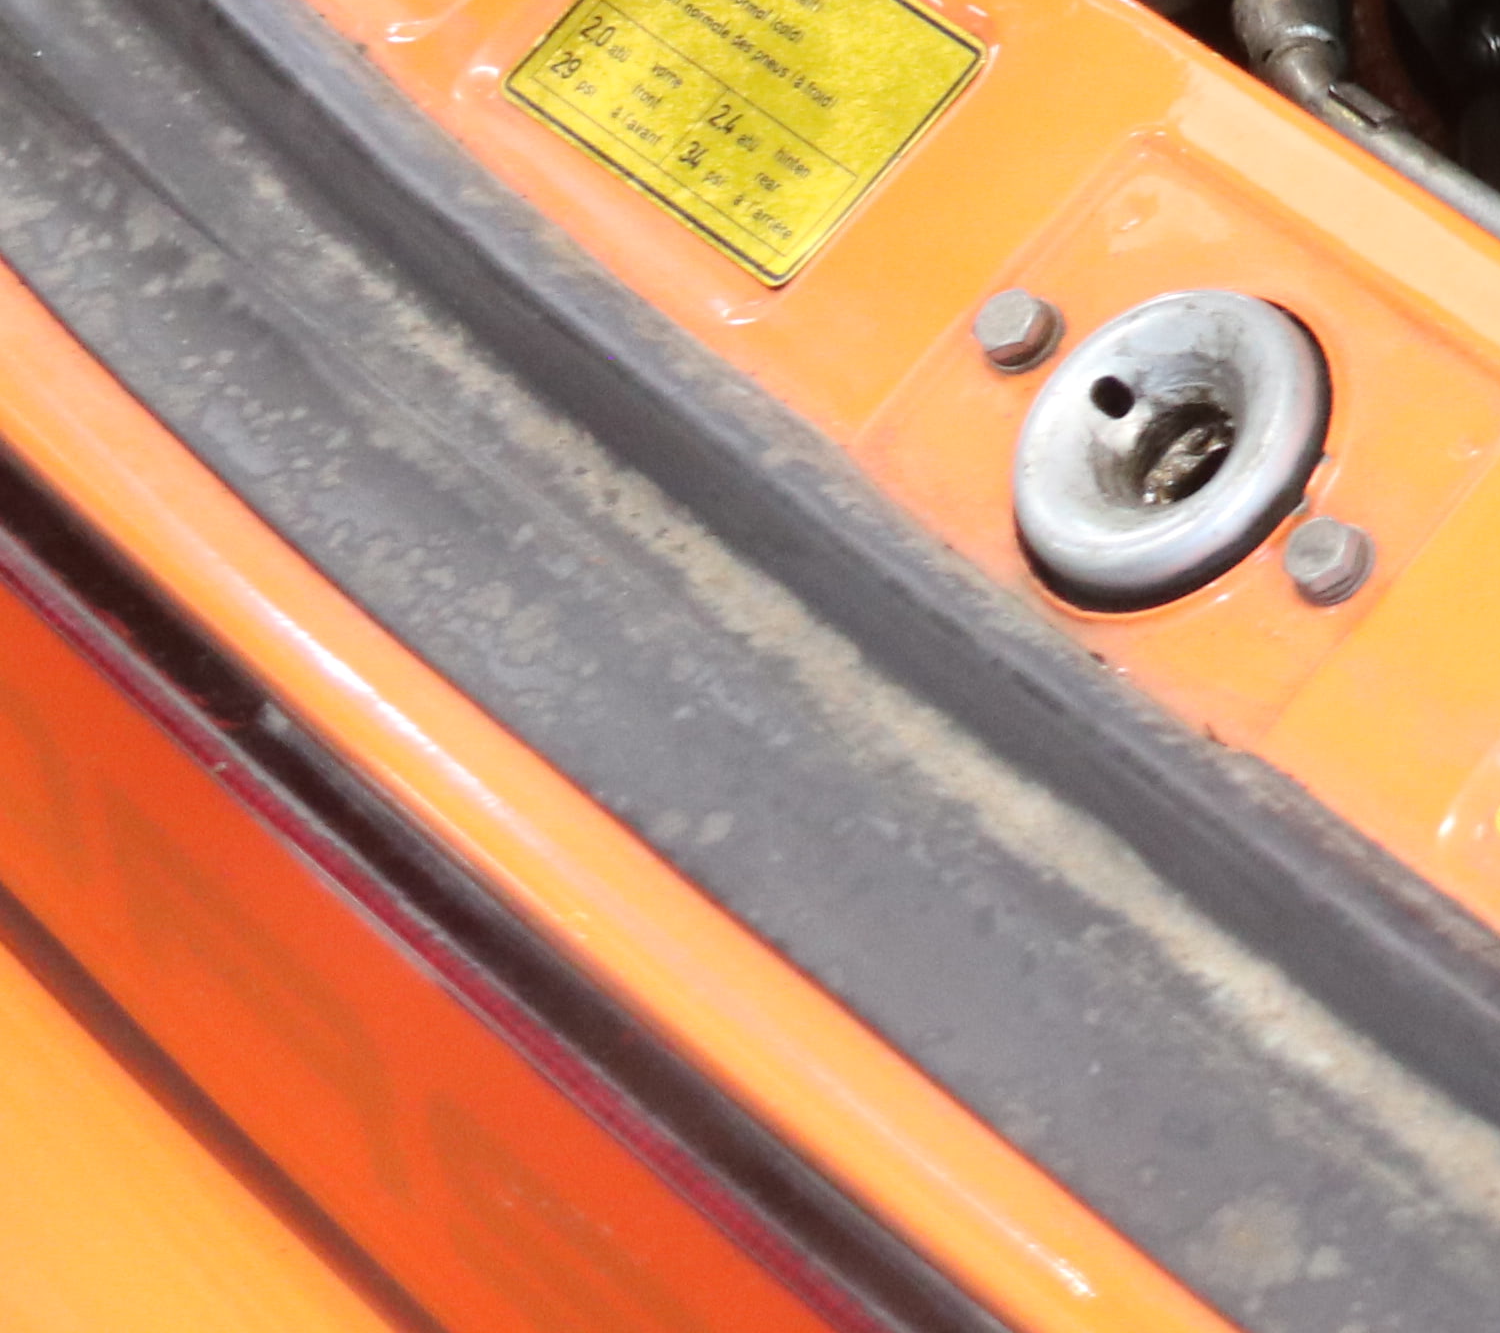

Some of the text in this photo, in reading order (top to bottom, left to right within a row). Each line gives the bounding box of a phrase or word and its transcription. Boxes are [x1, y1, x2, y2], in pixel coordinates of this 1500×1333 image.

[550, 50, 583, 80] 29
[751, 49, 789, 79] pneus
[630, 83, 662, 109] front
[678, 140, 709, 169] 34
[772, 146, 813, 178] hinten
[753, 171, 781, 194] rear
